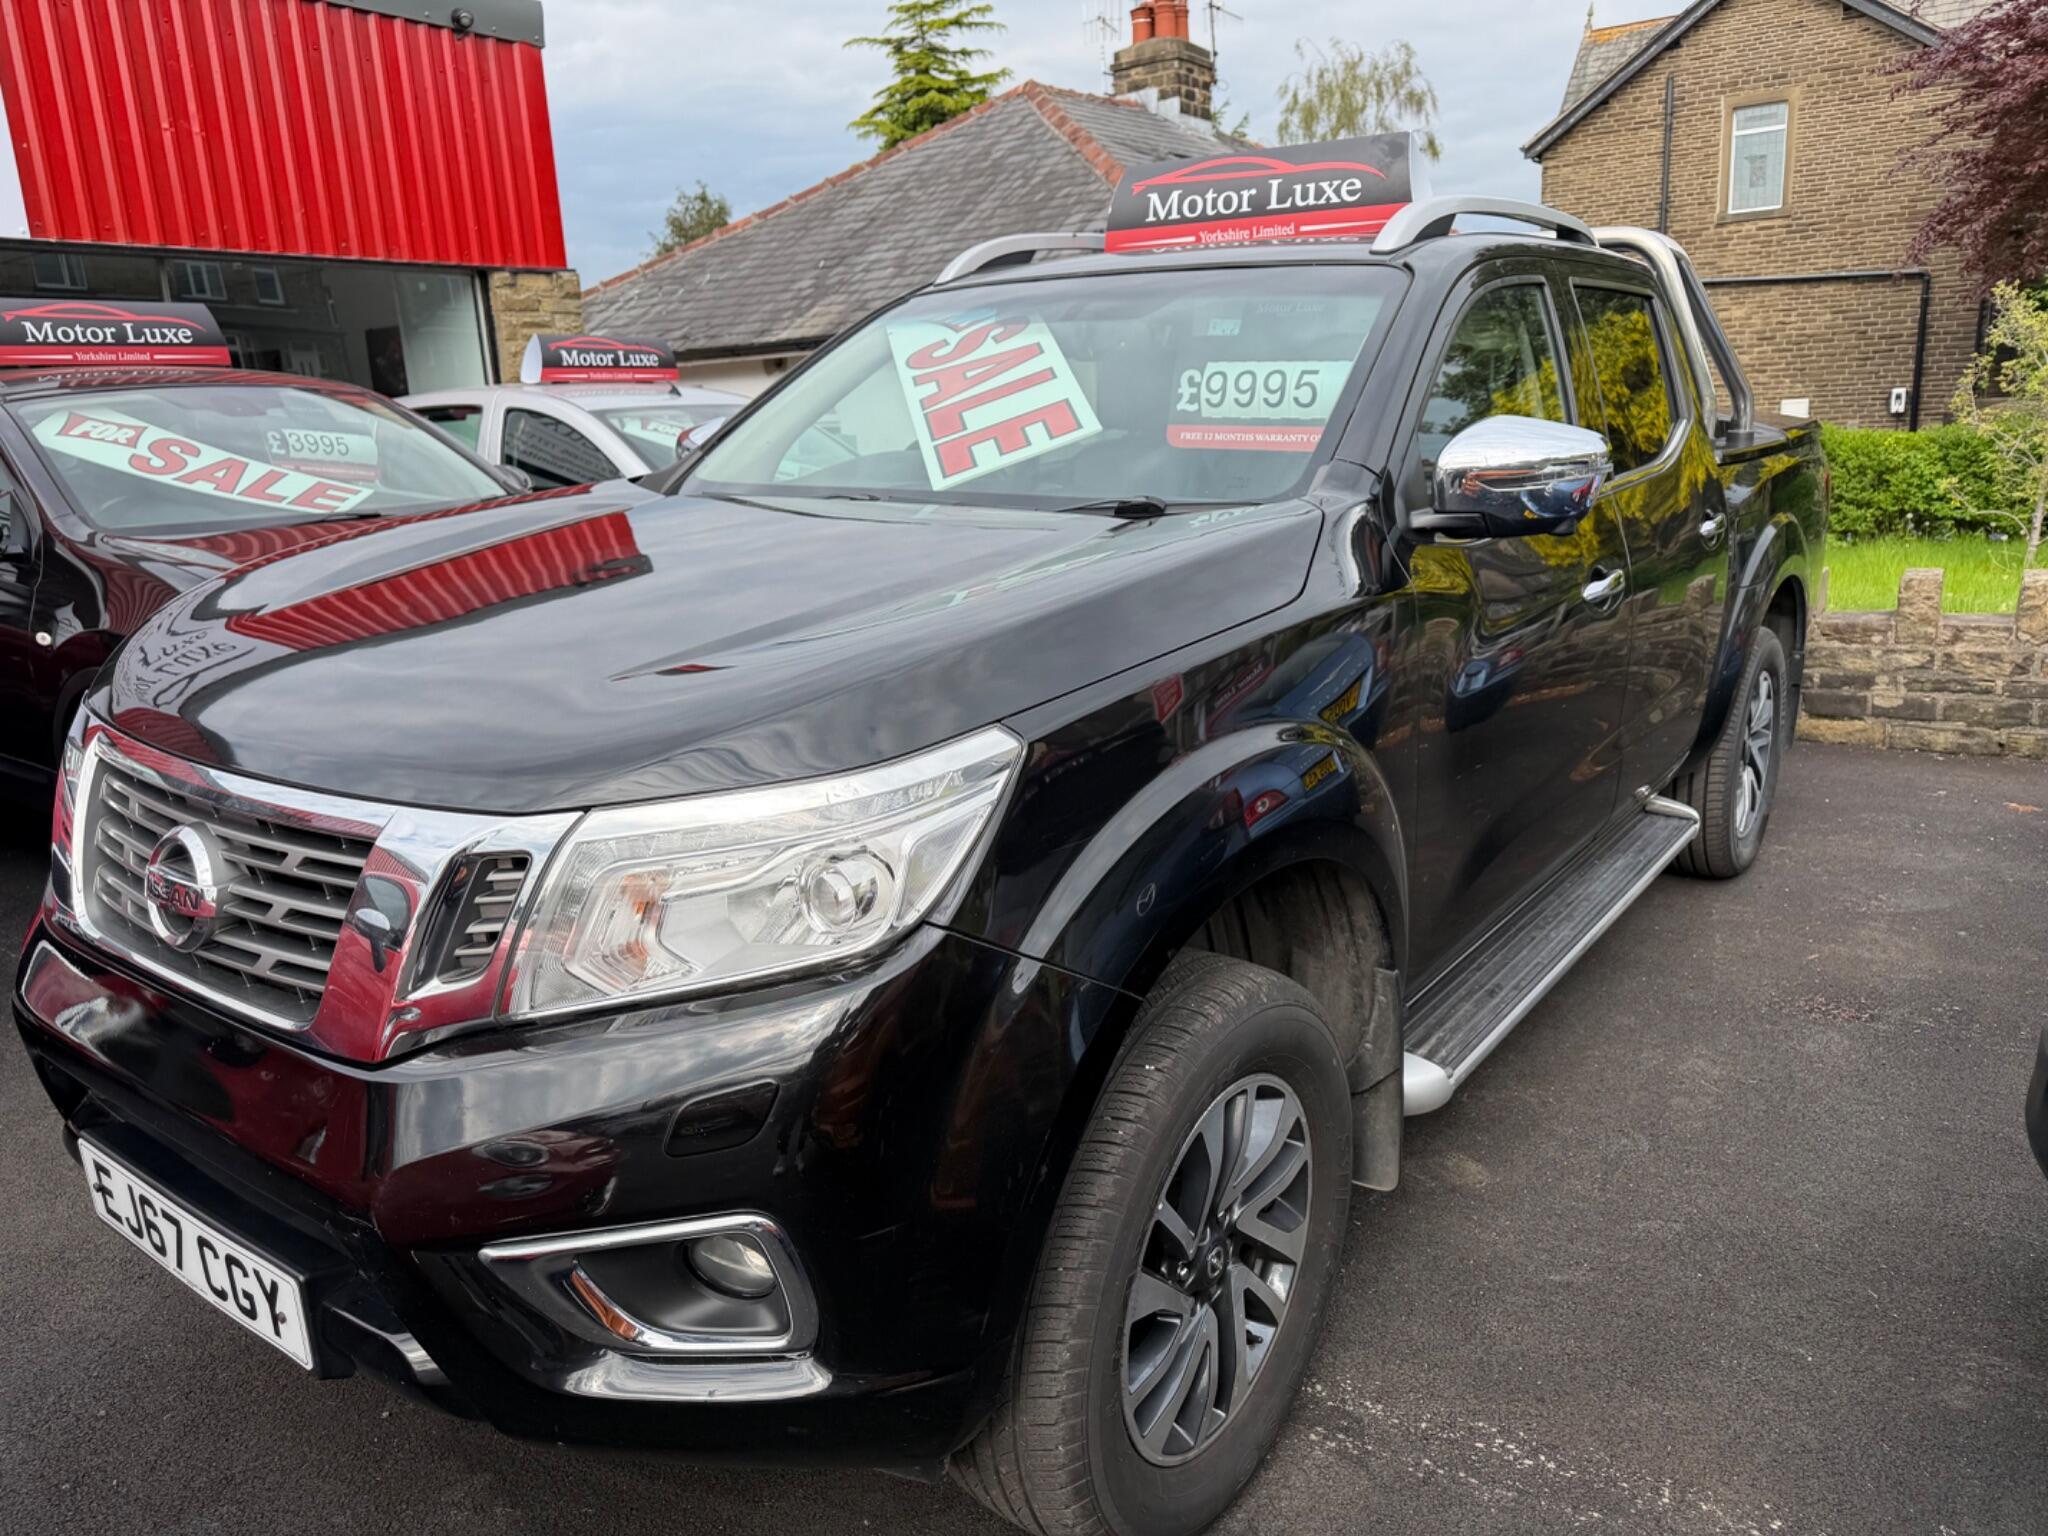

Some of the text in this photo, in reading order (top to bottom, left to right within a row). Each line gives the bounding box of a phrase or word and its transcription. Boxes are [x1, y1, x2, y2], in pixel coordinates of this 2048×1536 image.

[1144, 176, 1362, 222] Motor Luxe
[1199, 217, 1295, 243] Yorkshire Limited
[21, 321, 194, 344] Motor Luxe
[75, 351, 151, 361] Yorkshire Limited
[559, 349, 660, 367] Motor Luxe
[905, 316, 1084, 479] SALE
[1176, 368, 1321, 412] £9995
[69, 419, 138, 445] FOR
[267, 431, 349, 457] £3995
[1214, 432, 1255, 441] MONTHS
[1254, 432, 1309, 442] WARRANTY
[127, 437, 361, 512] SALE
[92, 1159, 282, 1339] EJ67 CGY
